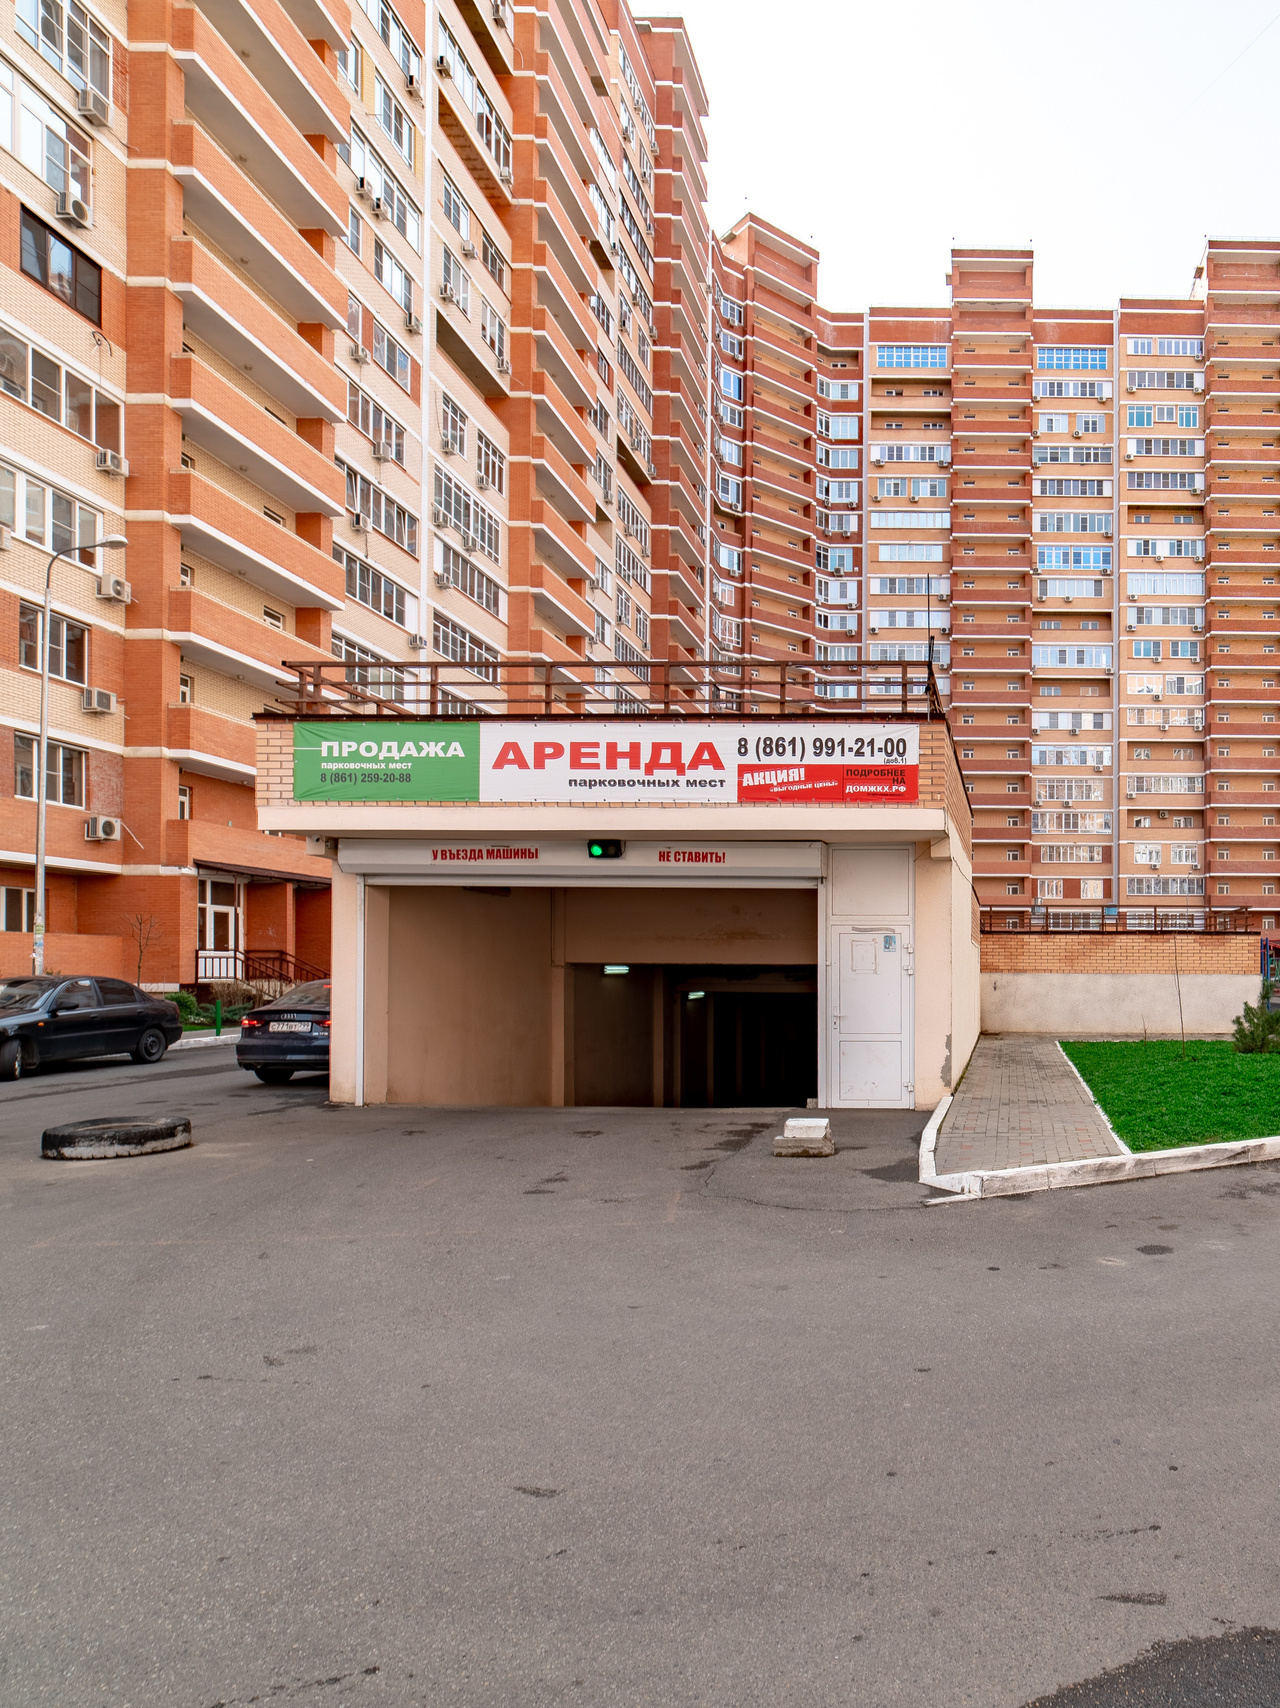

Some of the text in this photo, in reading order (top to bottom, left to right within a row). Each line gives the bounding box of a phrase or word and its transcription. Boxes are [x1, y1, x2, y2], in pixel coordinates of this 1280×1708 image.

[321, 741, 466, 760] ПРОДАЖА
[737, 736, 907, 762] 8 (861) 991-21-00
[492, 742, 725, 775] АРЕНДА
[321, 762, 386, 770] парковочных
[320, 773, 412, 785] 8 (861) 259-20-88
[742, 767, 805, 787] АКЦИЯ!
[845, 769, 906, 777] ПОДРОБНЕЕ
[568, 778, 726, 788] парковочных мест
[892, 777, 906, 785] НА
[845, 785, 907, 793] ДОМЖКХ.РФ
[432, 848, 538, 861] У ВЪЕЗДА МАШИНЫ
[658, 850, 726, 863] НЕ СТАВИТЬ!
